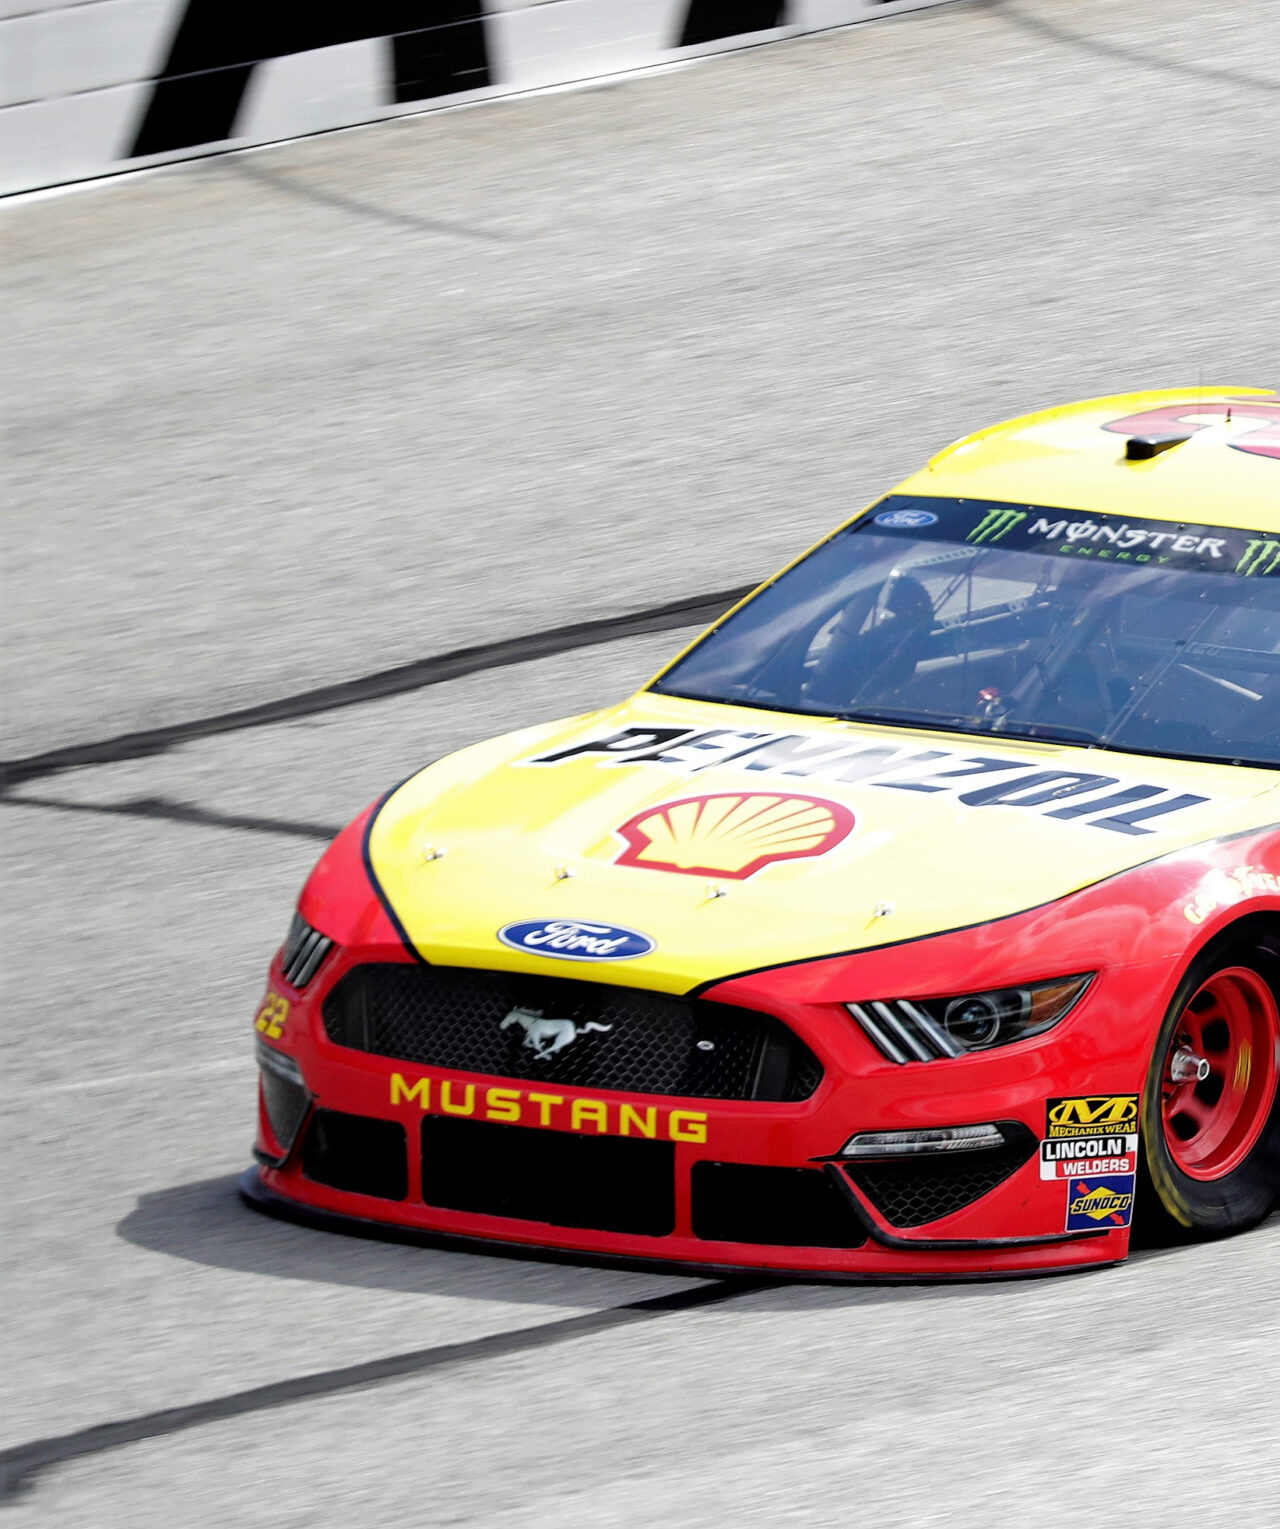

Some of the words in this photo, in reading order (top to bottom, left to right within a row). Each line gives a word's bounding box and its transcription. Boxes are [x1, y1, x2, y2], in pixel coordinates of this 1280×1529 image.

[1058, 543, 1174, 566] ENERGY
[532, 726, 1212, 837] PENNZOIL
[523, 919, 630, 956] Ford
[255, 991, 290, 1040] 22
[389, 1072, 709, 1144] MUSTANG
[1048, 1125, 1104, 1138] MECHANIX
[1105, 1120, 1137, 1134] WEAR
[1045, 1138, 1122, 1160] LINCOLN
[1063, 1158, 1130, 1176] WELDERS
[1072, 1195, 1130, 1213] SUNOCO
